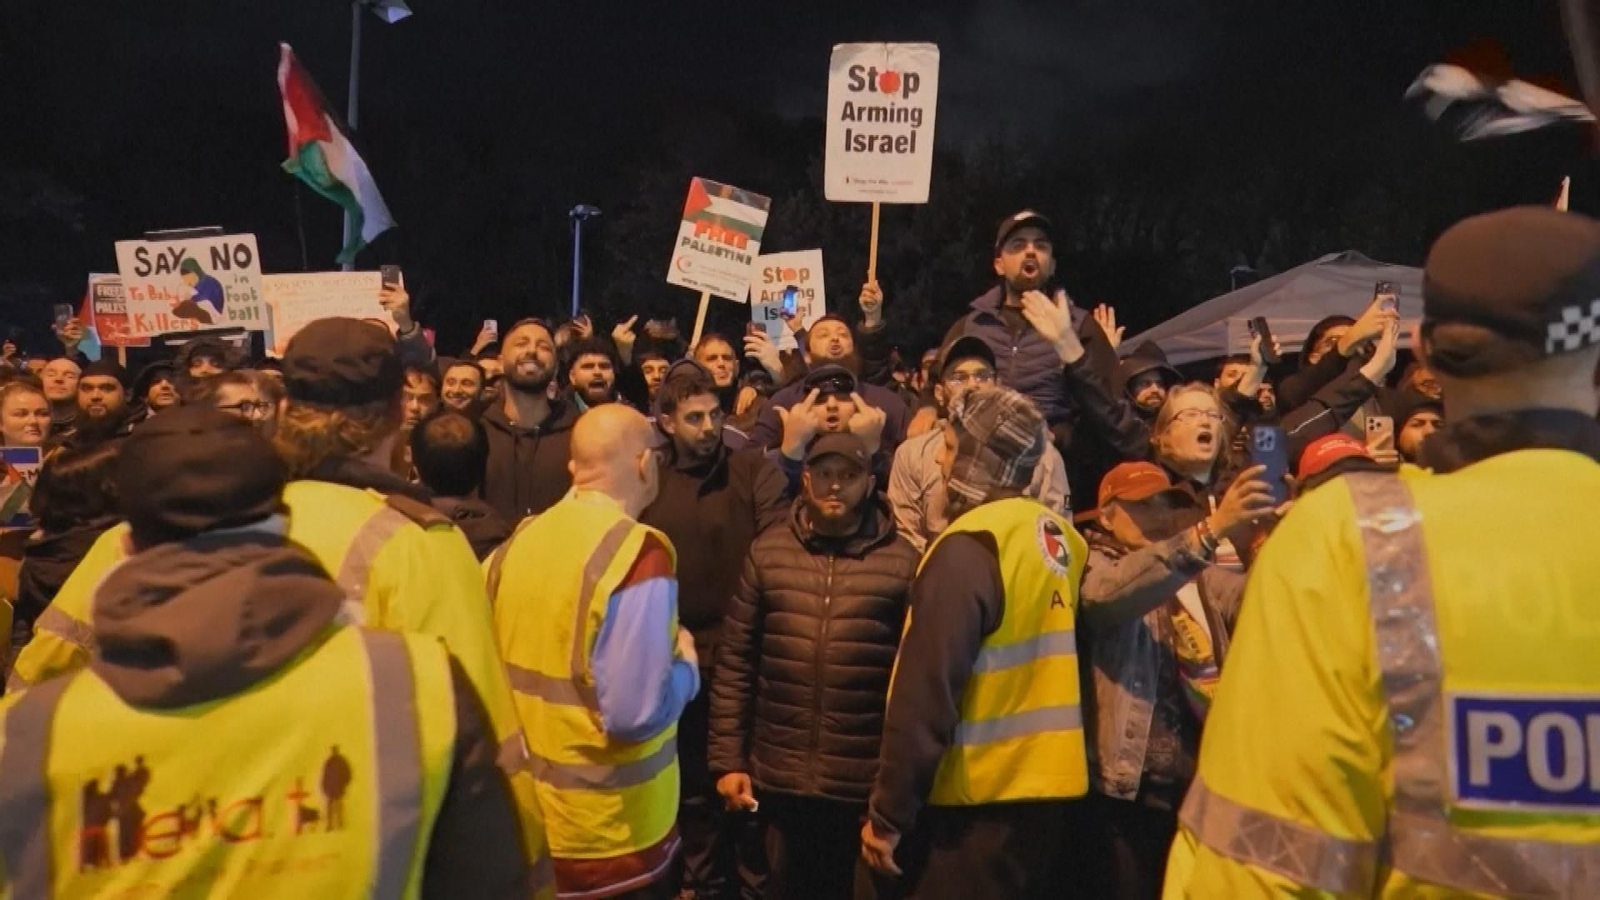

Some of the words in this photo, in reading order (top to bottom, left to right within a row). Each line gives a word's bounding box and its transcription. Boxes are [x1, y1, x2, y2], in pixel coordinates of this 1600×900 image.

[841, 101, 923, 128] Arming
[845, 128, 916, 154] Israel
[134, 246, 187, 277] SAY
[210, 243, 252, 270] NO
[681, 236, 752, 265] PALESTINE
[233, 273, 249, 283] in
[129, 287, 145, 301] To
[134, 312, 200, 333] Killers
[228, 306, 260, 321] ball
